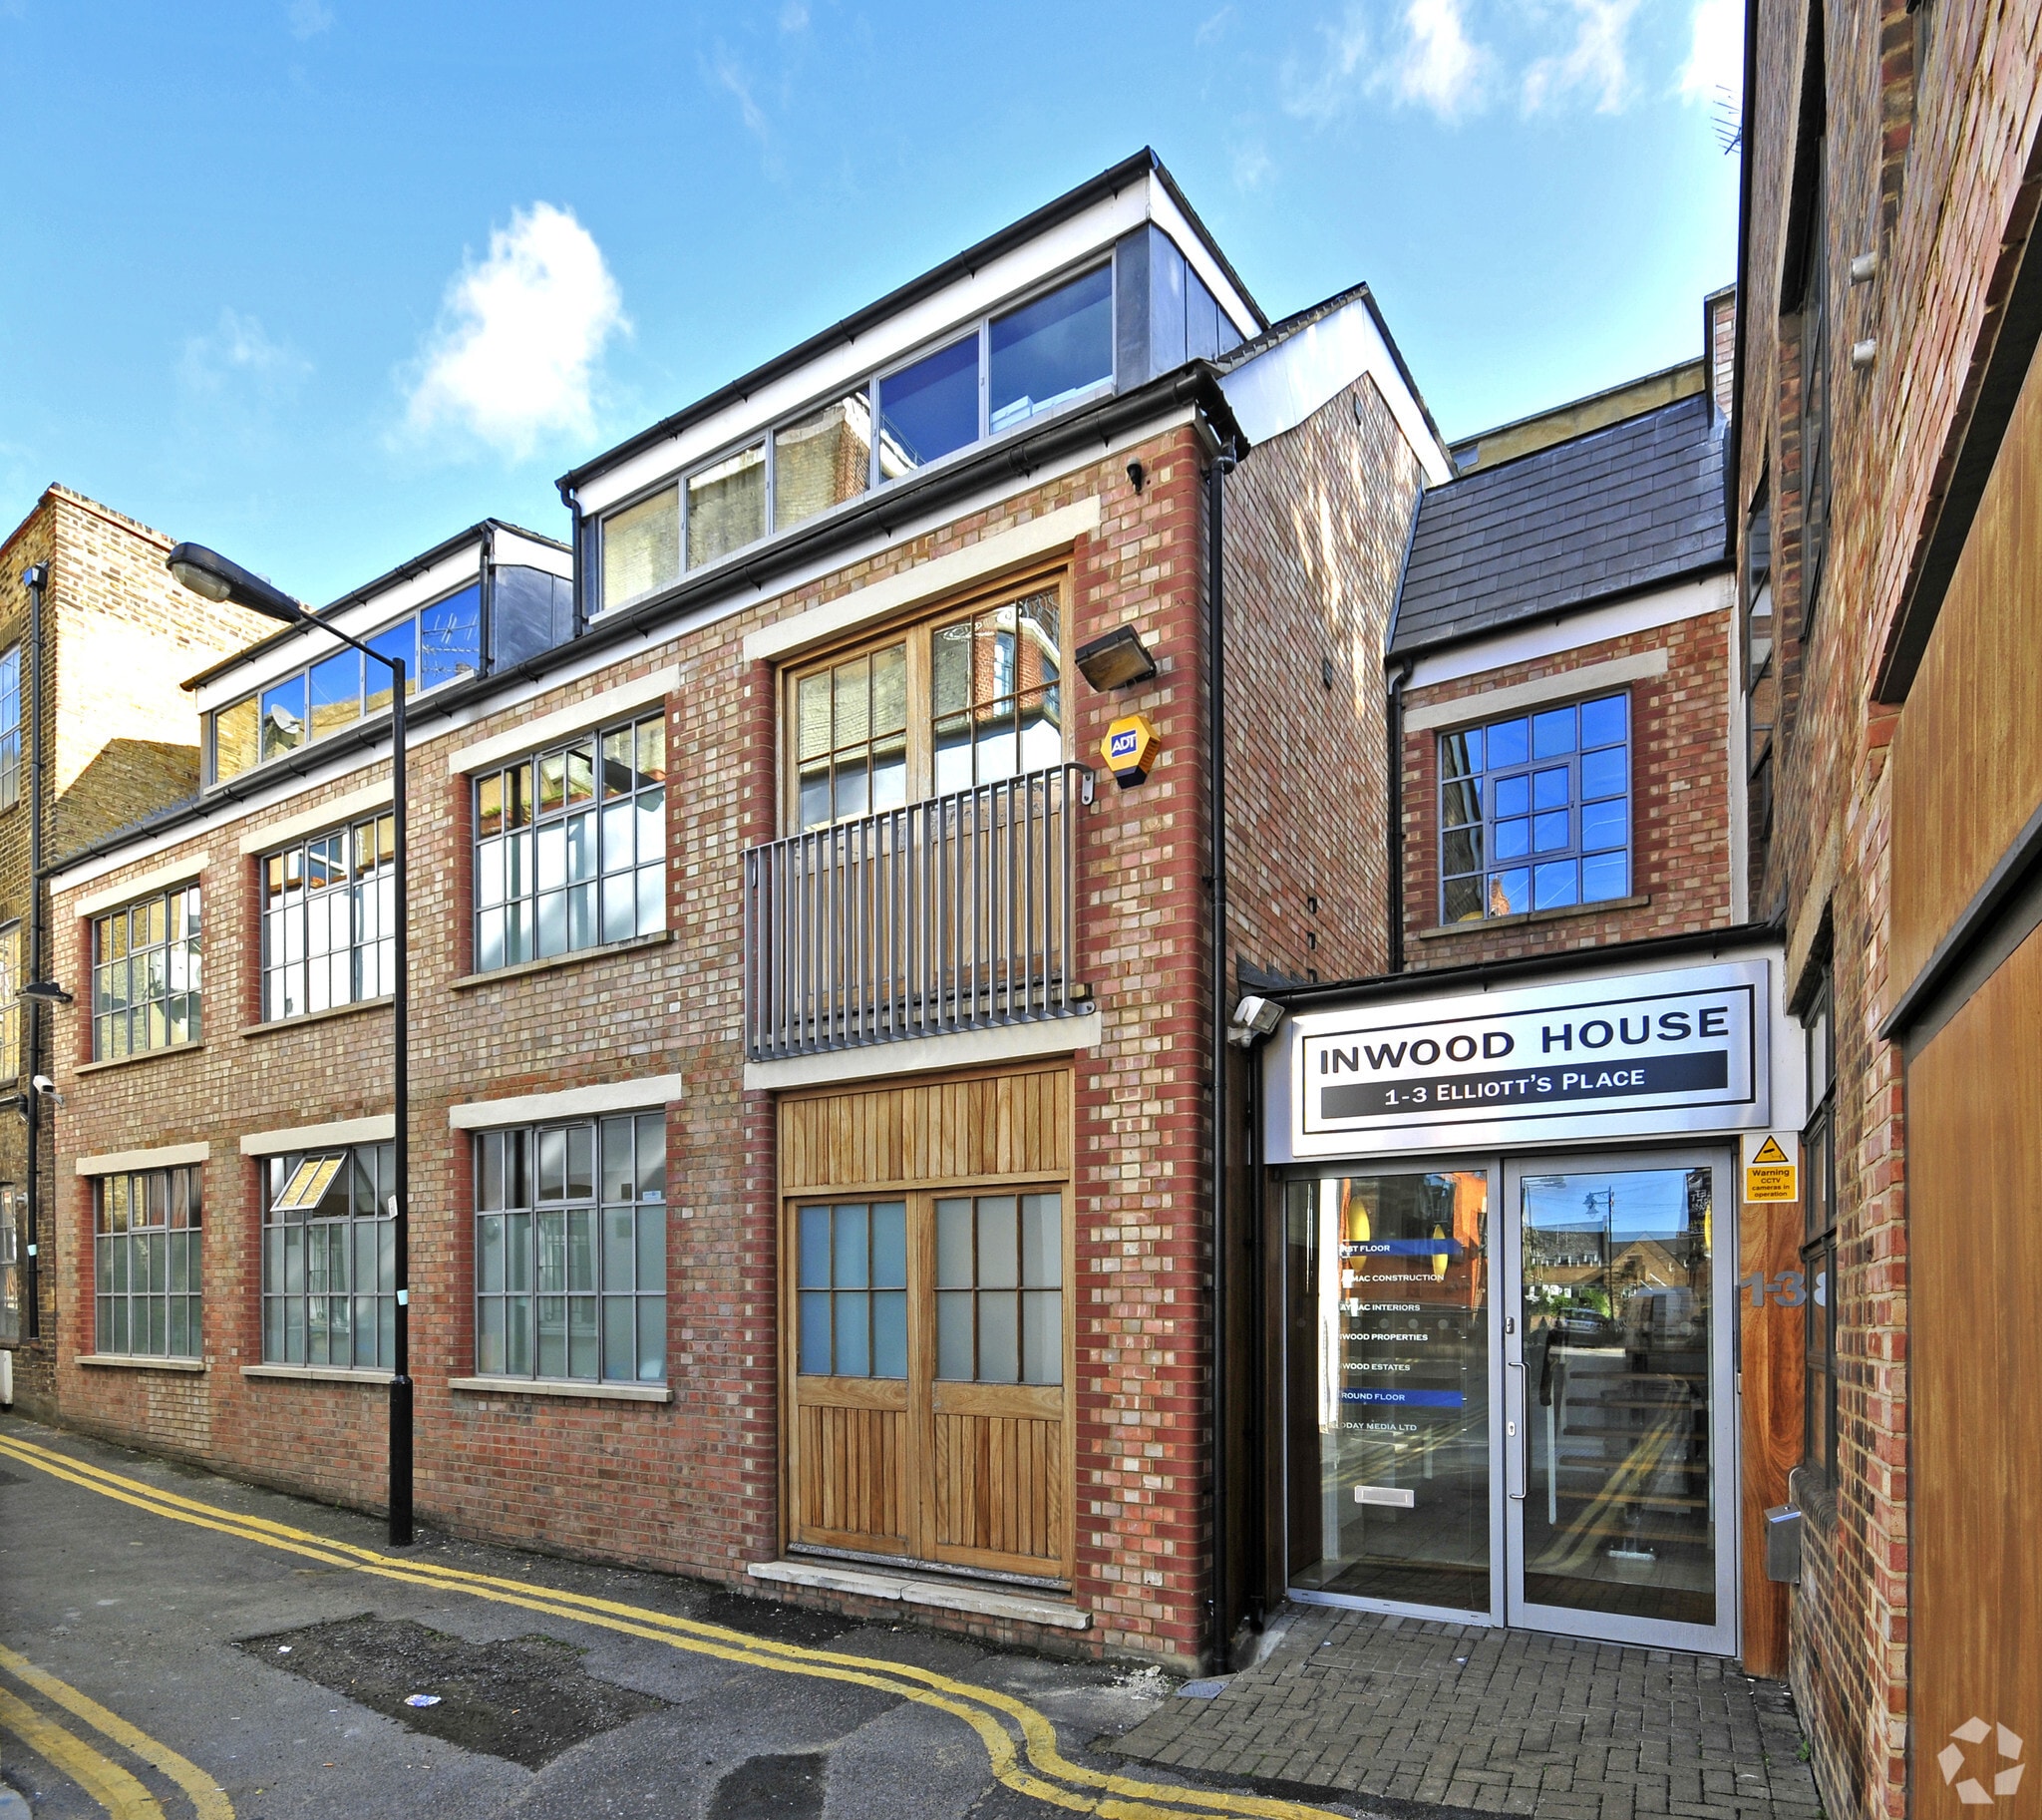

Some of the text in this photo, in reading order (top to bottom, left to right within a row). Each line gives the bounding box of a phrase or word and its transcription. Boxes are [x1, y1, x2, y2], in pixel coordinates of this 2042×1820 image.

[1112, 733, 1137, 754] ADT
[1321, 1006, 1729, 1074] INWOOD HOUSE
[1385, 1069, 1645, 1106] 1-3 ELLIOTT'S PLACE
[1372, 1274, 1445, 1282] CONSTRUCTION
[1739, 1271, 1807, 1307] 1-3
